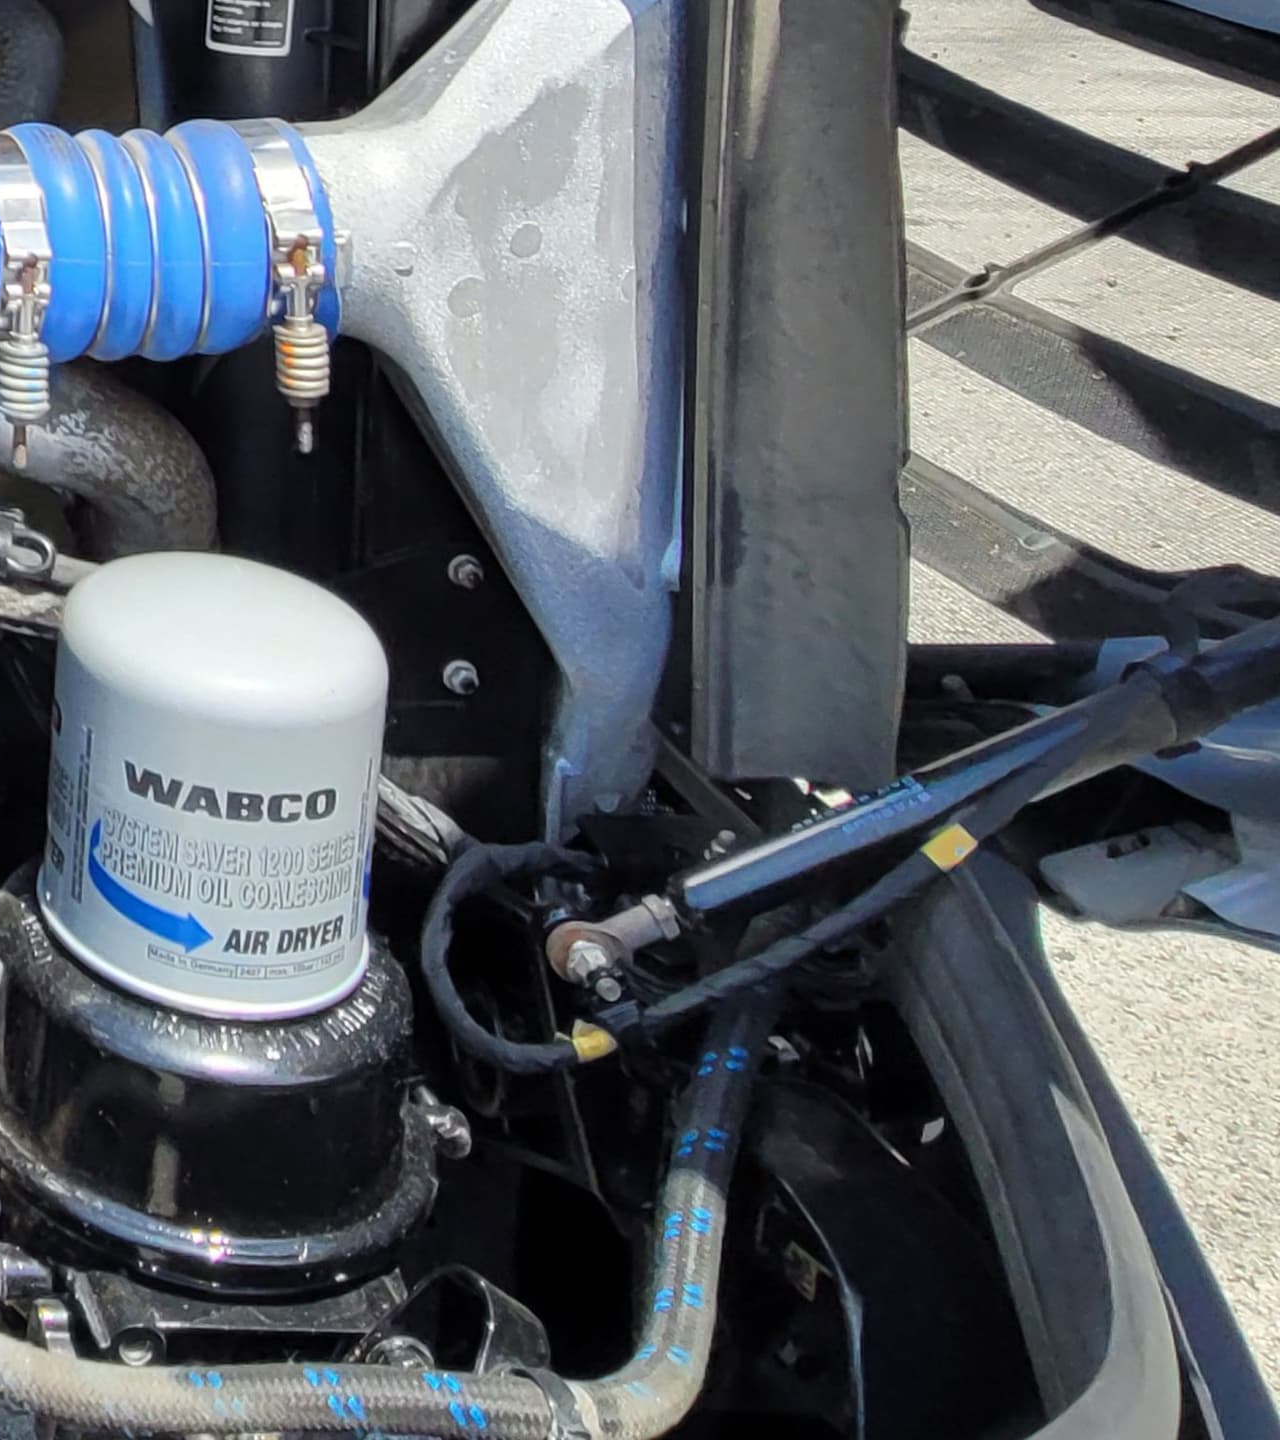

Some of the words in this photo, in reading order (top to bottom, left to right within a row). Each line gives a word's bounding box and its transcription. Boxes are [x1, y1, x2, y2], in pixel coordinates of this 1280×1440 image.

[124, 759, 336, 823] WABCO
[101, 839, 192, 901] PREMIUM
[197, 873, 233, 908] OIL
[103, 809, 179, 864] SYSTEM
[183, 839, 251, 876] SAVER
[258, 846, 302, 876] 1200
[307, 830, 356, 873] SERIES
[223, 927, 270, 955] AIR
[276, 915, 344, 955] DRYER
